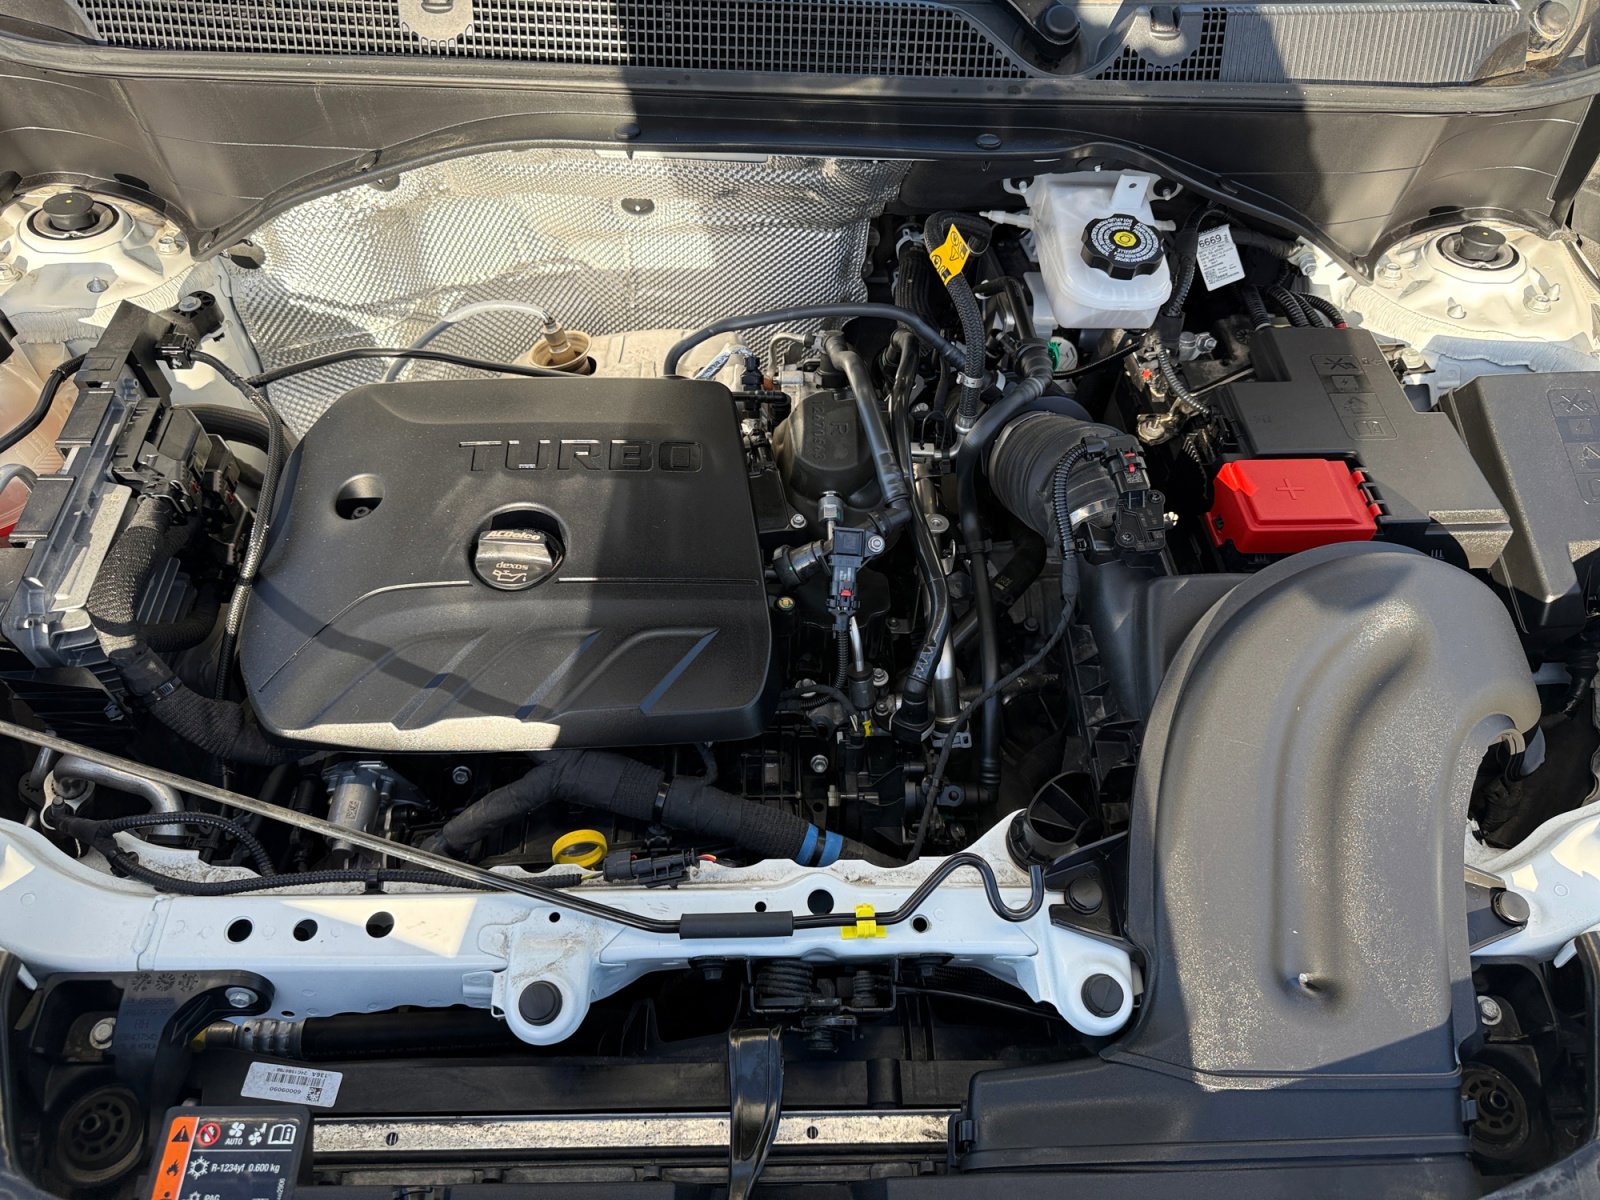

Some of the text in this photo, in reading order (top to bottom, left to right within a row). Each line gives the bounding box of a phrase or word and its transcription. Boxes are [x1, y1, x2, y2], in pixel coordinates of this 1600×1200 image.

[1198, 234, 1222, 248] 6669
[458, 439, 704, 473] TURBO
[485, 530, 541, 541] ACDelco
[495, 561, 529, 571] dexos
[224, 1137, 243, 1146] AUTO
[210, 1163, 281, 1174] R-1234yf 0.600 kg
